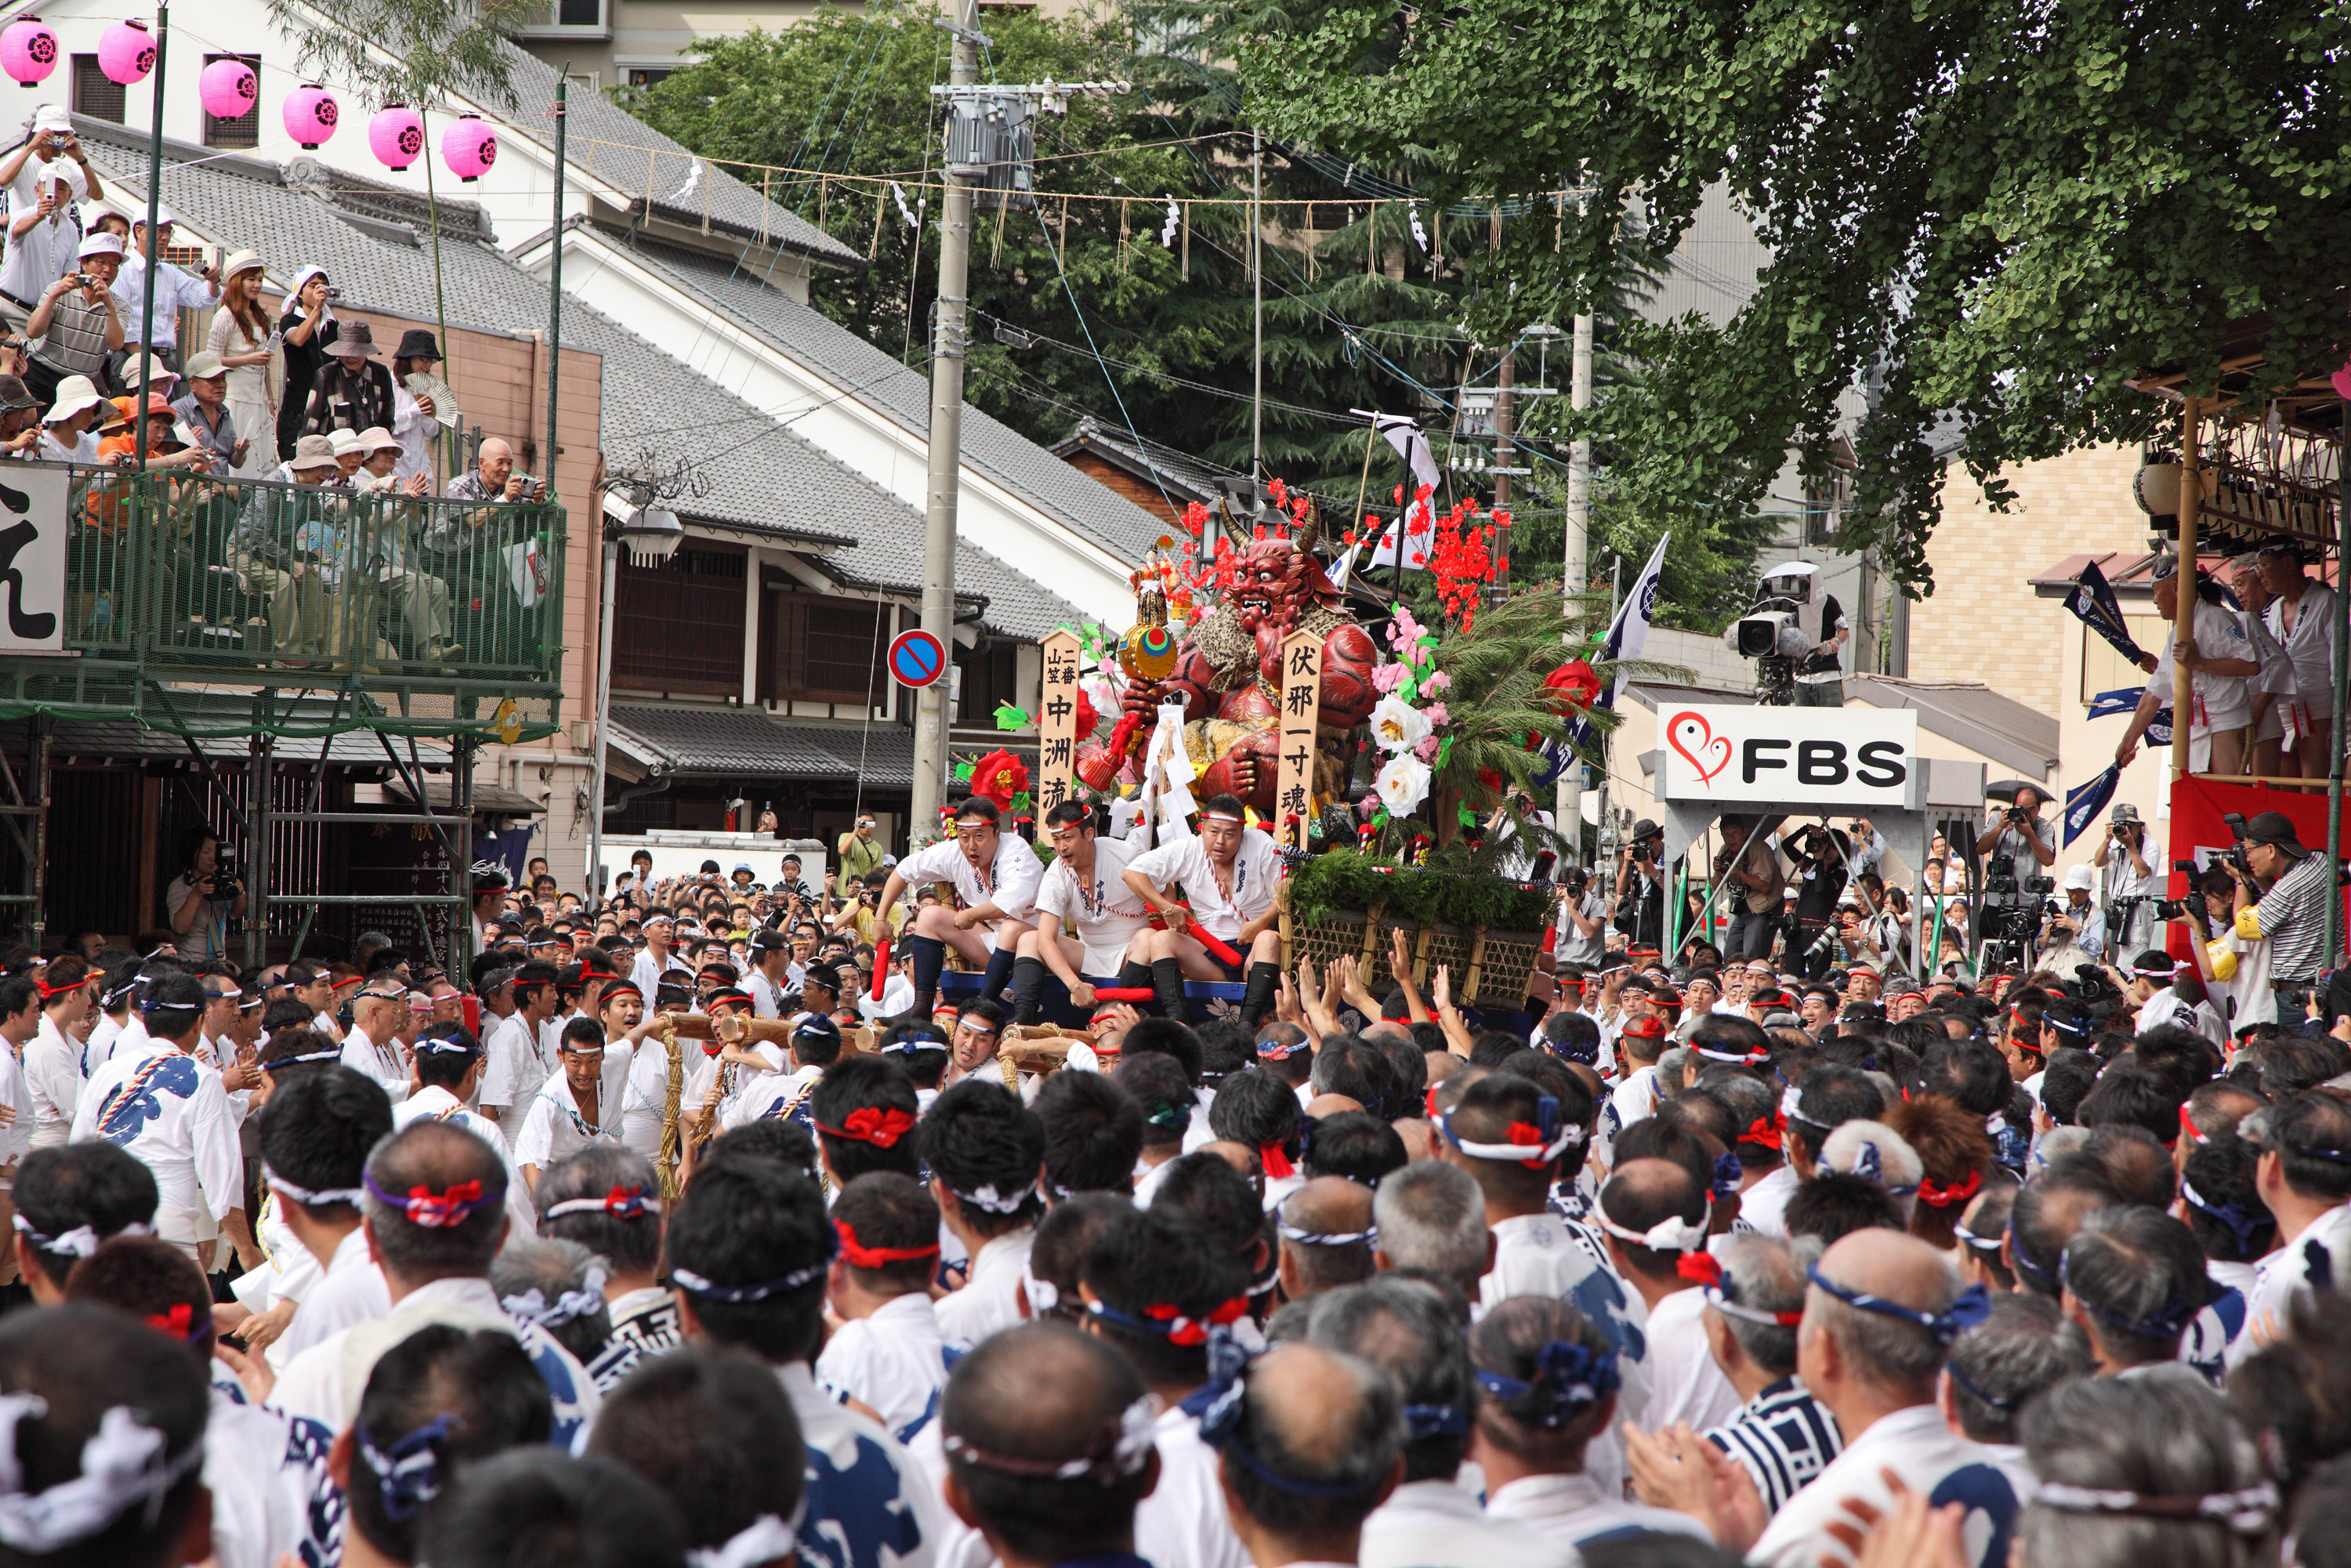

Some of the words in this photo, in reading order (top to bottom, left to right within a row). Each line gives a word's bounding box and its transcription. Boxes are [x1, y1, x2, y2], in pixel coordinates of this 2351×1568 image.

[1047, 648, 1061, 684] 山笠
[1061, 650, 1076, 685] 二番
[1043, 694, 1073, 809] 中洲流
[1281, 645, 1317, 816] 伏邪一寸魂
[1742, 738, 1906, 788] FBS
[435, 845, 450, 972] 第四十八式年遷宮
